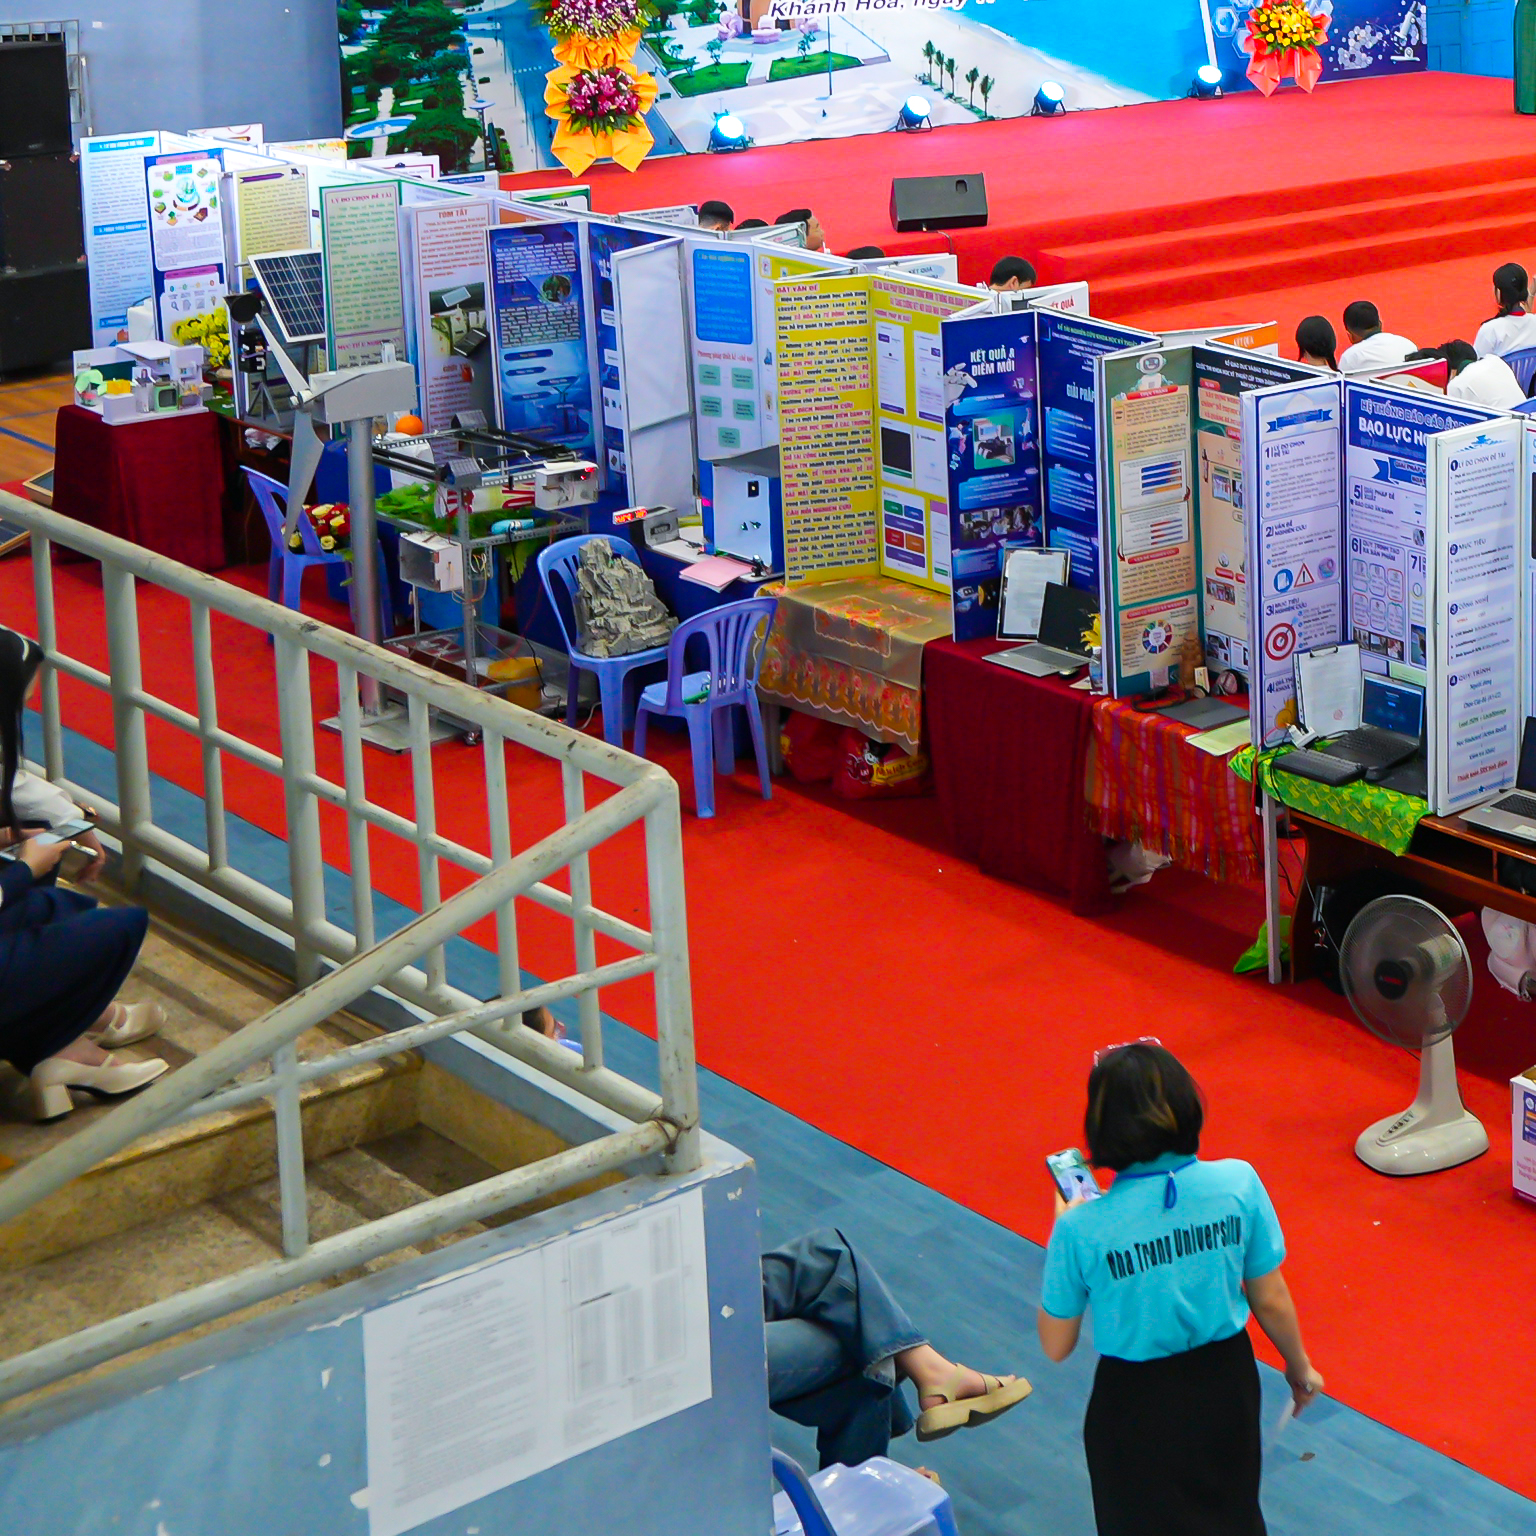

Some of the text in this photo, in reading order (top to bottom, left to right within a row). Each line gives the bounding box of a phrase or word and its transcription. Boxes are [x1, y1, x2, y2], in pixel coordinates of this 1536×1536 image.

[970, 350, 987, 363] KẾT
[988, 346, 1007, 361] QUẢ
[971, 359, 1016, 377] ĐIỂM MỚI
[1358, 417, 1384, 439] BẠO
[1106, 1215, 1242, 1280] Nha Trang University
